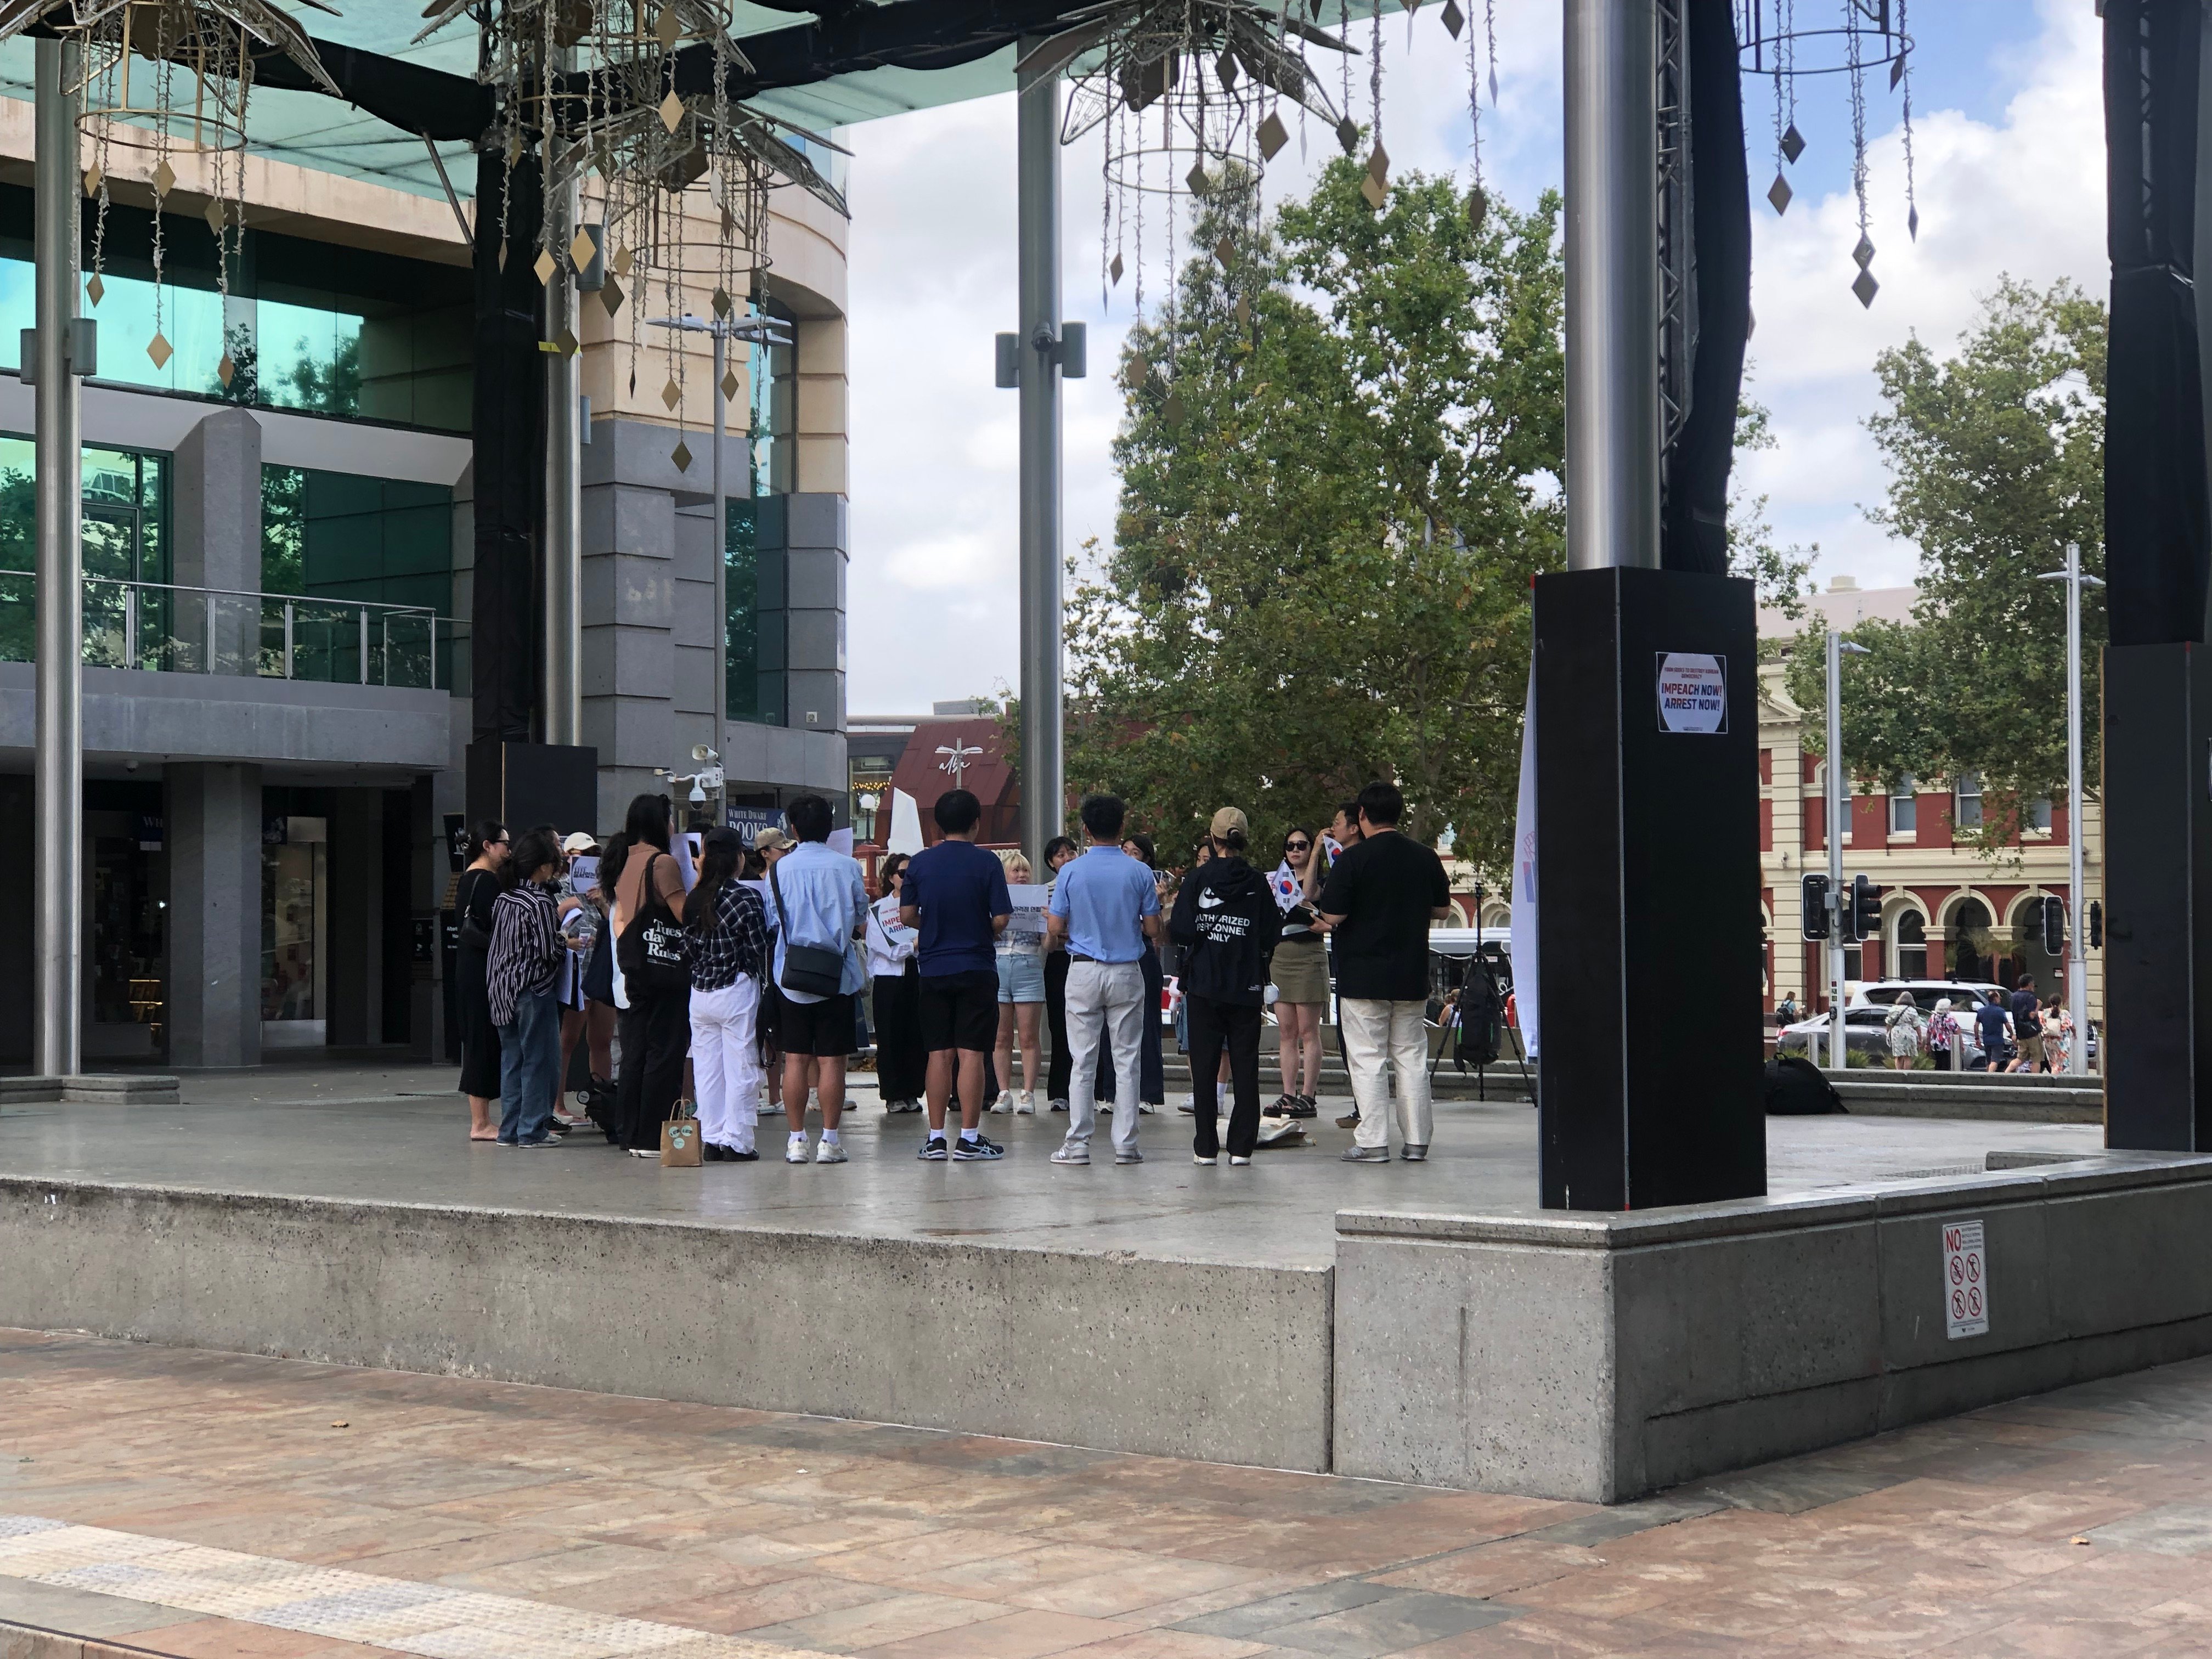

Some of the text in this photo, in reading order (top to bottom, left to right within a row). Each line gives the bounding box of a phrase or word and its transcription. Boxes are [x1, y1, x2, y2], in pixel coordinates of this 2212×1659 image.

[1661, 682, 1723, 697] IMPEACH NOW!
[1664, 697, 1720, 712] ARREST NOW!
[653, 918, 682, 938] Tues
[882, 916, 900, 927] IMPE
[642, 927, 667, 947] day
[1207, 932, 1230, 943] ONLY
[647, 942, 681, 961] Rules
[1946, 1228, 1961, 1253] NO
